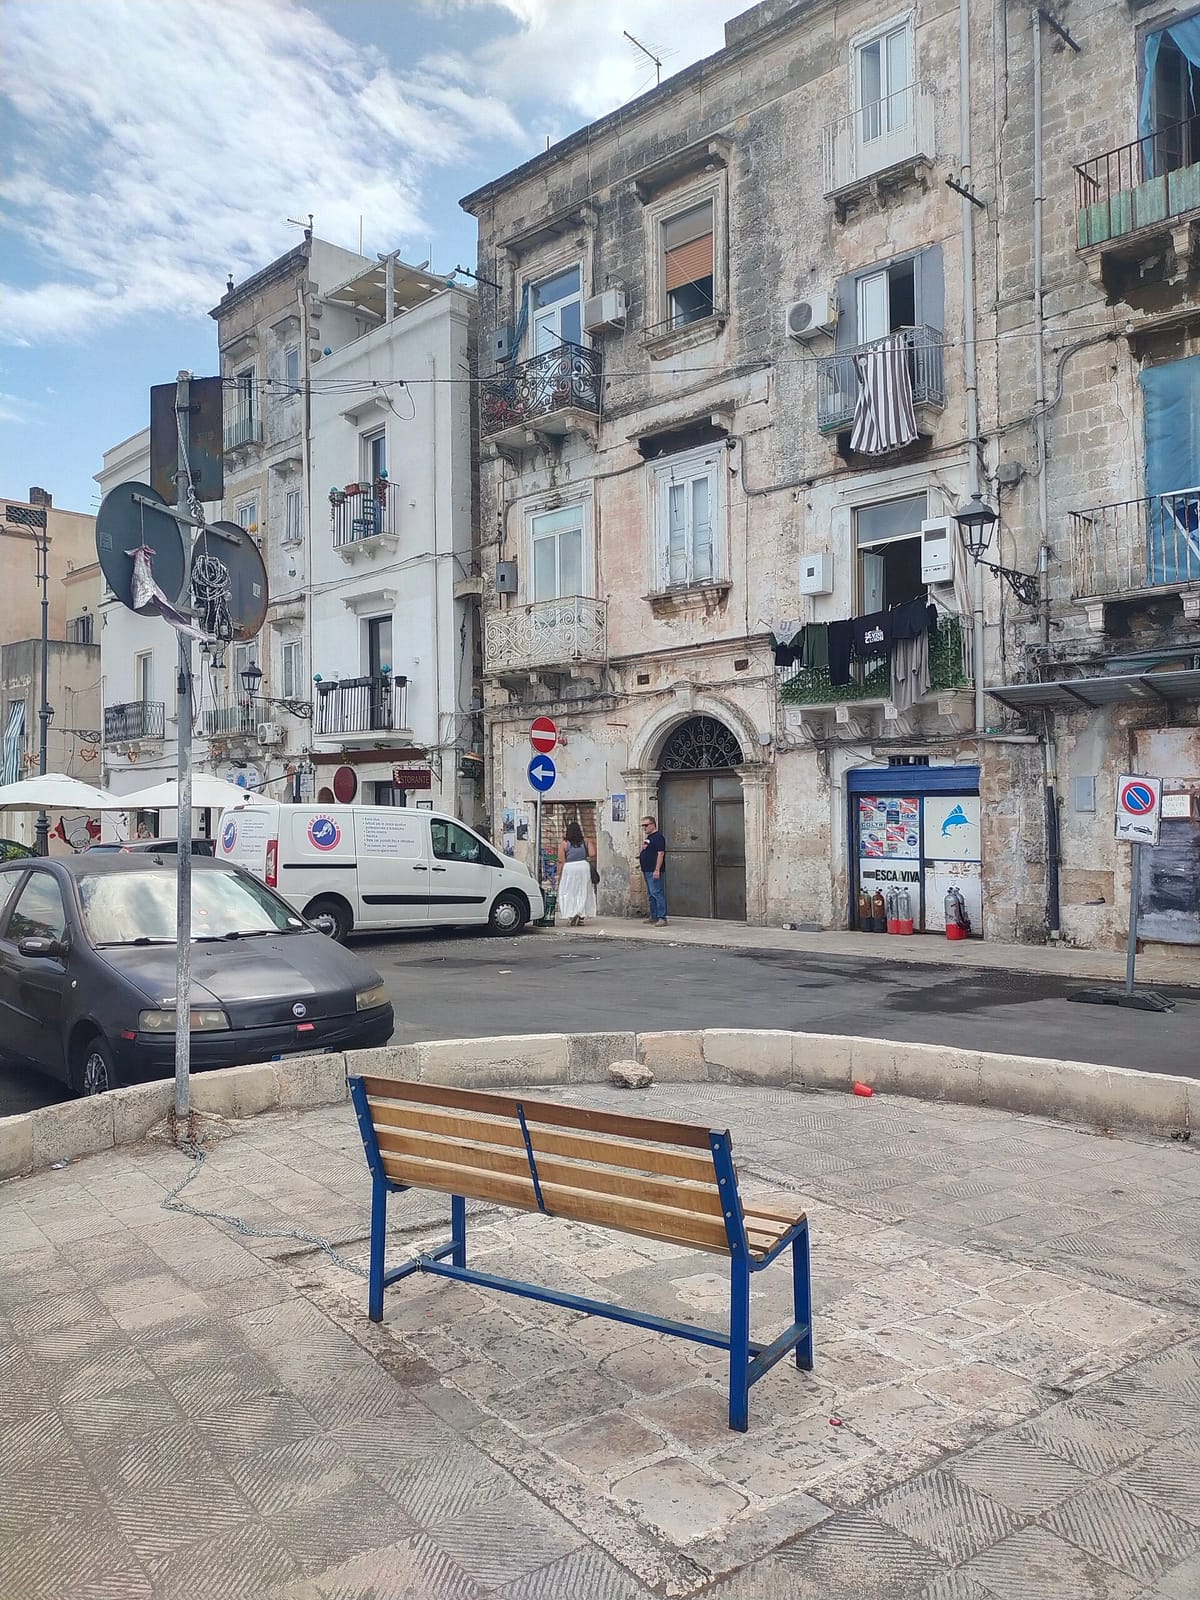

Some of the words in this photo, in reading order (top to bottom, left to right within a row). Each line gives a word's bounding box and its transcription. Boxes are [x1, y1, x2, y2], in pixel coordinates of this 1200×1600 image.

[400, 775, 430, 784] STORANTE
[875, 870, 898, 882] ESCA
[901, 871, 920, 882] VIVA
